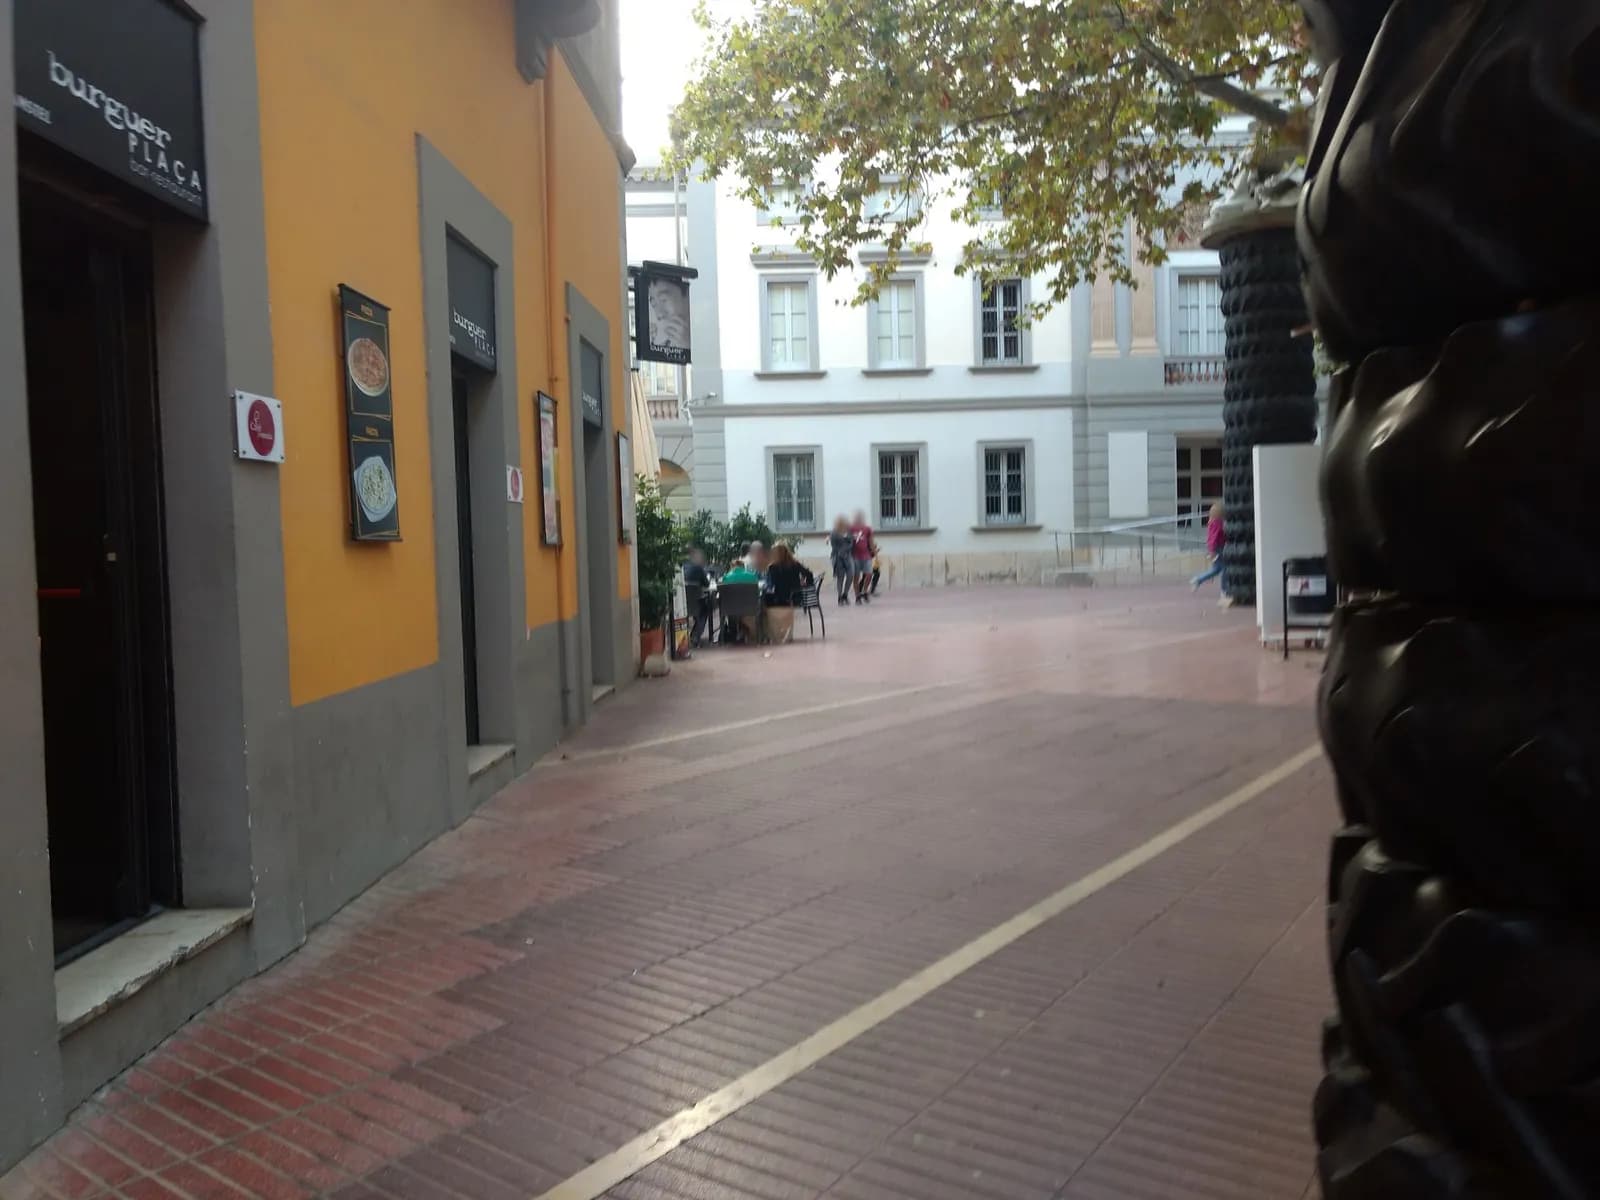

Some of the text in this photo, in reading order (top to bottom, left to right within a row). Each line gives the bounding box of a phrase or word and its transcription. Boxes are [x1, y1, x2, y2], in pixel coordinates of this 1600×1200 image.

[46, 49, 172, 149] burguer
[128, 131, 202, 193] PLAÇA
[453, 306, 487, 340] burguer
